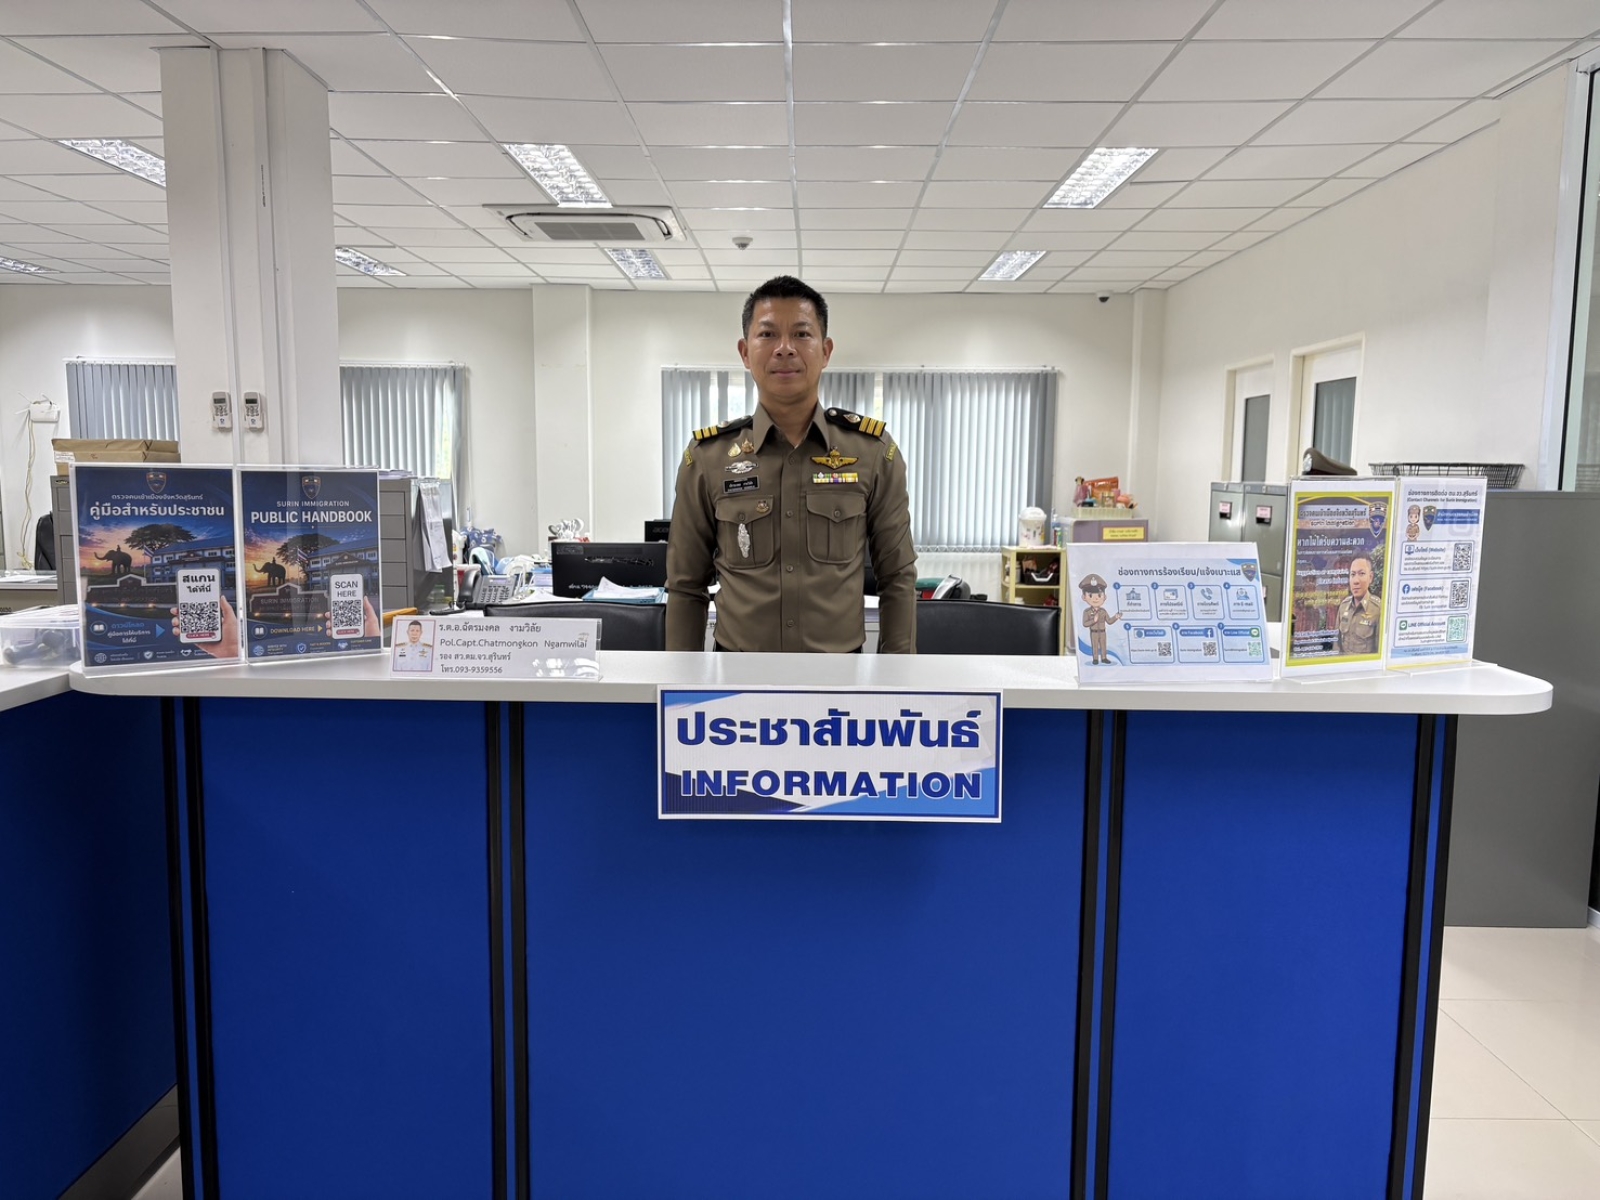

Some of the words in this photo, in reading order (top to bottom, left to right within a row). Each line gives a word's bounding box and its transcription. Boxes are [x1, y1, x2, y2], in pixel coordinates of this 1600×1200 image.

[90, 502, 225, 520] คู่มือสำหรับประชาชน
[251, 512, 298, 523] PUBLIC
[302, 511, 372, 522] HANDBOOK
[1298, 535, 1364, 546] หากไม่ได้รับความสะดวก
[1118, 567, 1241, 576] ช่องทางการร้องเรียน/แจ้งเบาะแส
[182, 573, 216, 583] สแกน
[335, 581, 358, 589] SCAN
[439, 622, 500, 632] ร.ต.อ.ฉัตรมงคล
[509, 622, 541, 632] งามวิลัย
[440, 639, 538, 649] Pol.Capt.Chatmongkon
[545, 640, 587, 649] Ngamwilai
[455, 652, 511, 663] สว.ตม.จว.สุรินทร์
[441, 664, 503, 674] โทร.093-9359556
[677, 708, 982, 748] ประชาสัมพันธ์
[681, 770, 982, 798] INFORMATION
